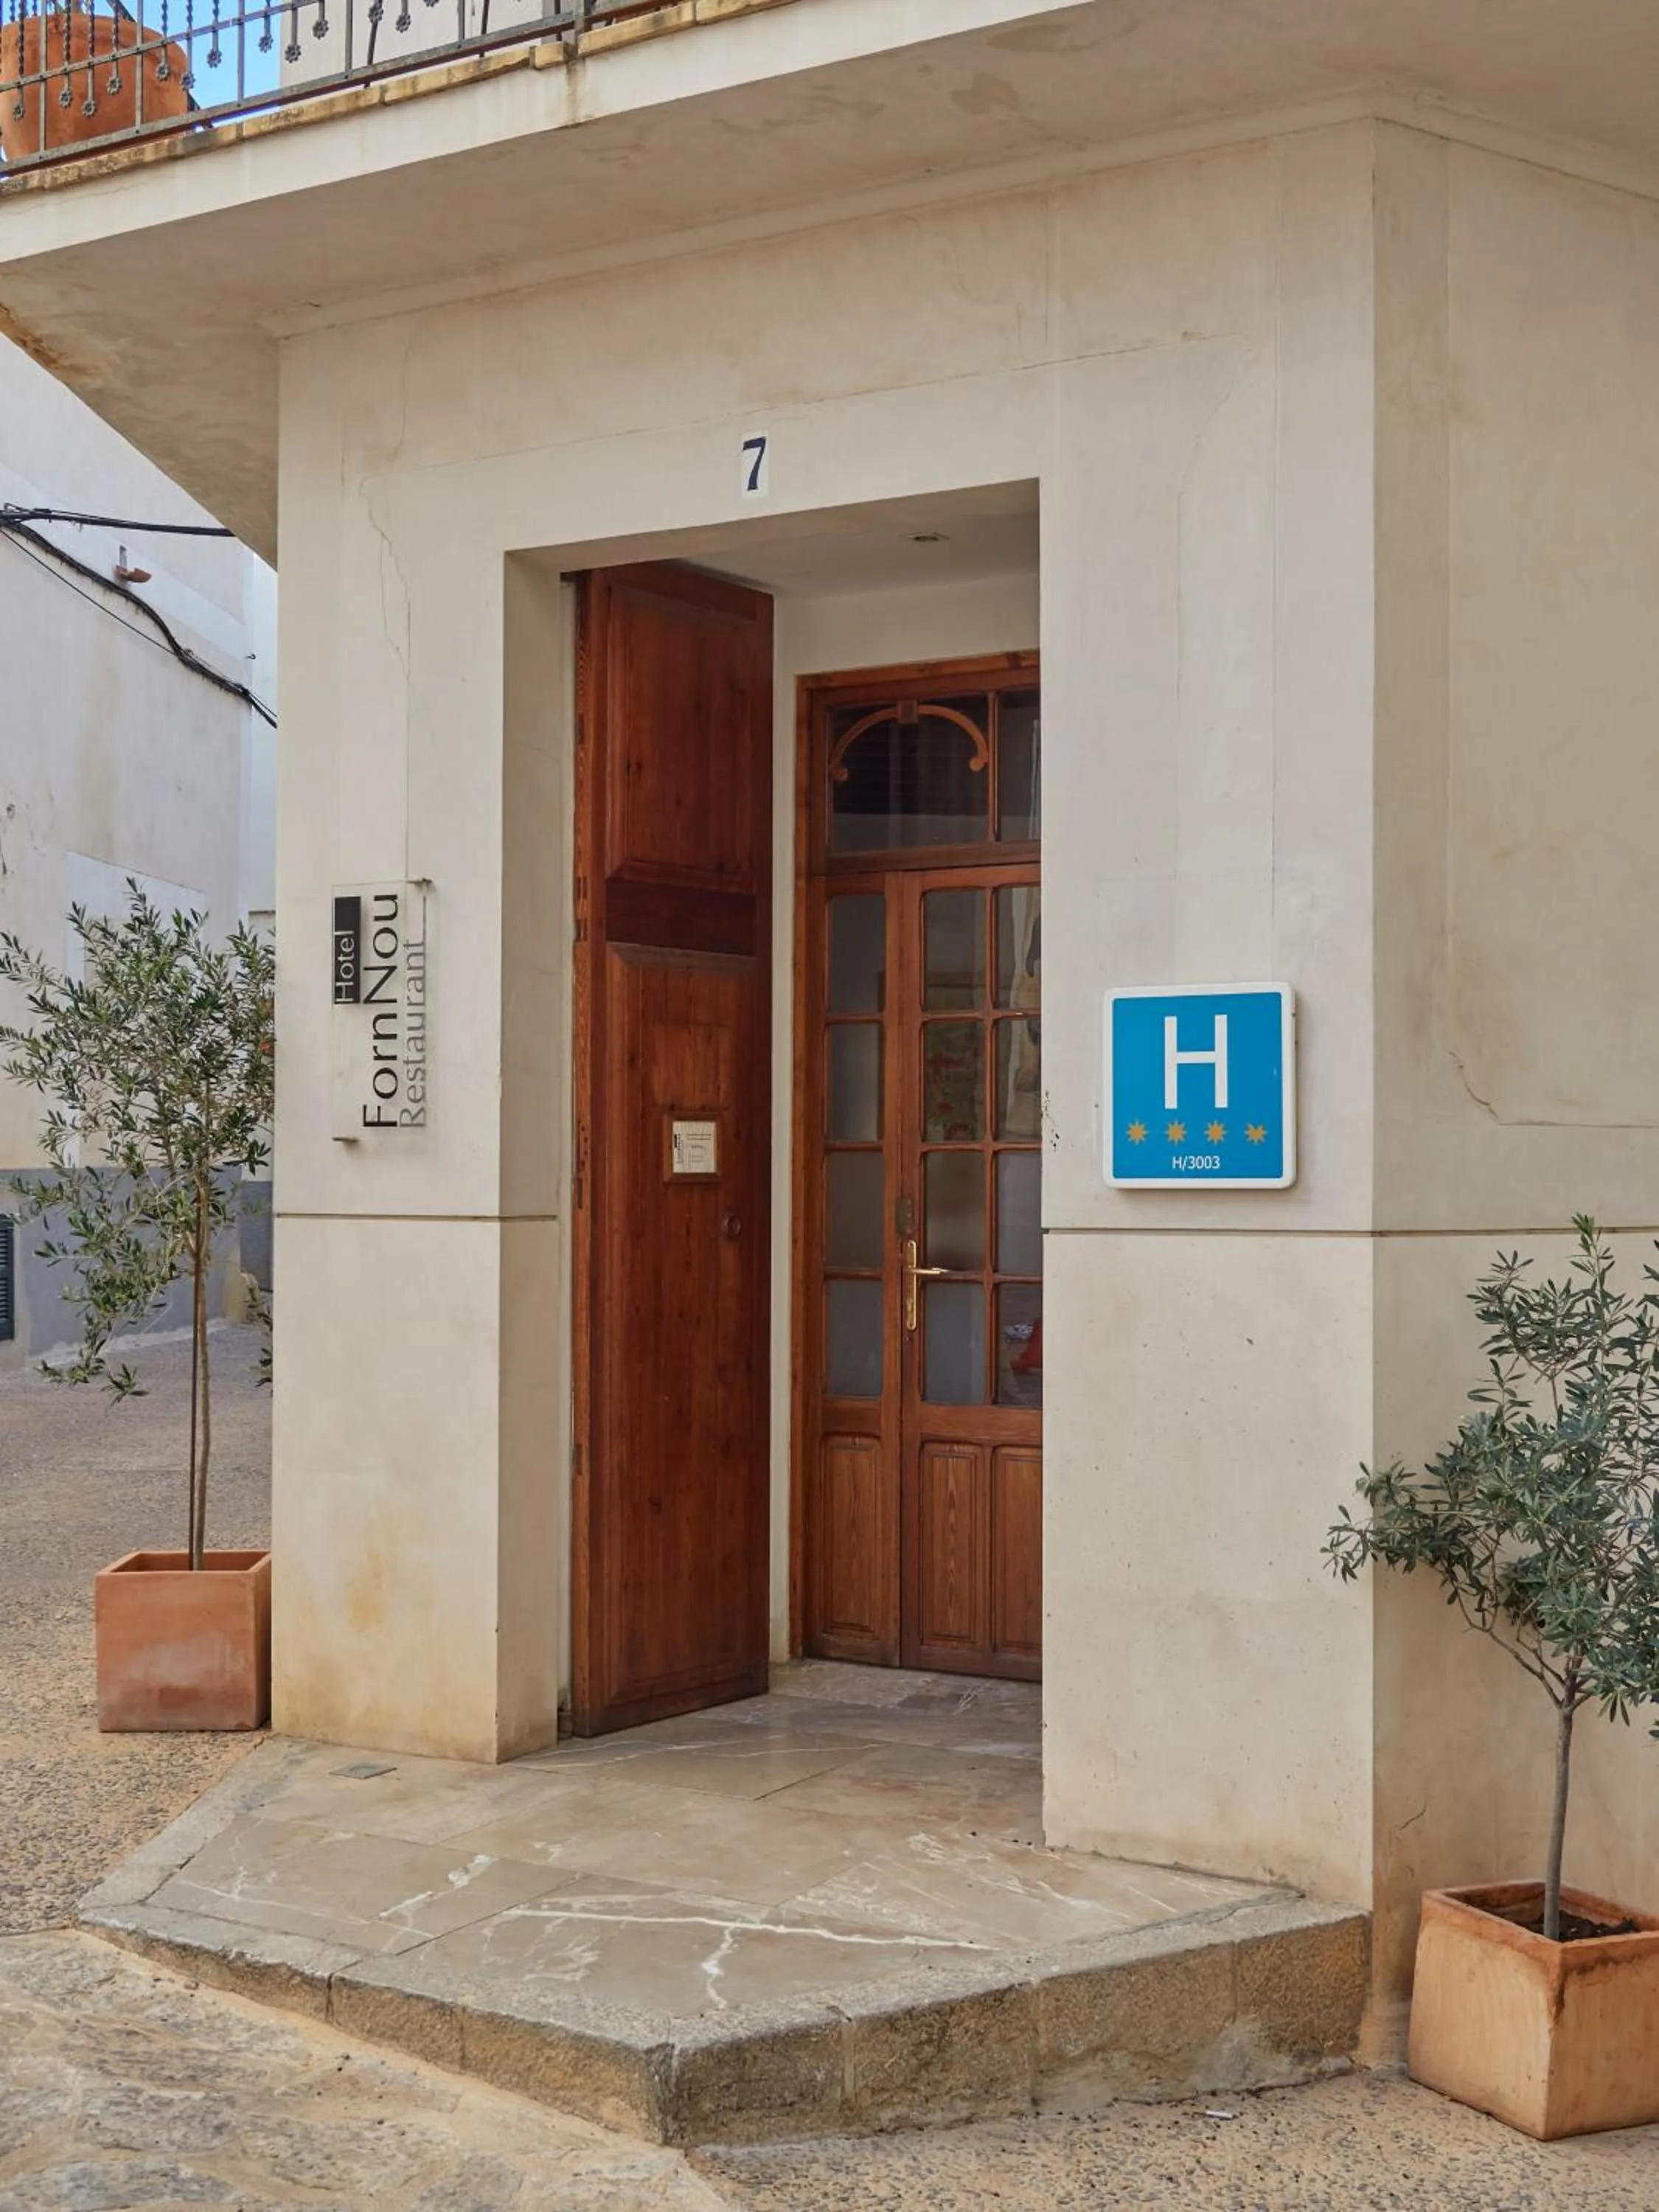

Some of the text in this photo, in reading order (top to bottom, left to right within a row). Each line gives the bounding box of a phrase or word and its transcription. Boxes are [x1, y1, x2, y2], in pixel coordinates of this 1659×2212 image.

[742, 436, 767, 491] 7
[333, 930, 355, 1003] Hotel
[362, 894, 398, 1127] FornNou
[399, 939, 425, 1127] Restaurant
[1164, 1014, 1228, 1110] H
[1172, 1155, 1221, 1171] H/3003
